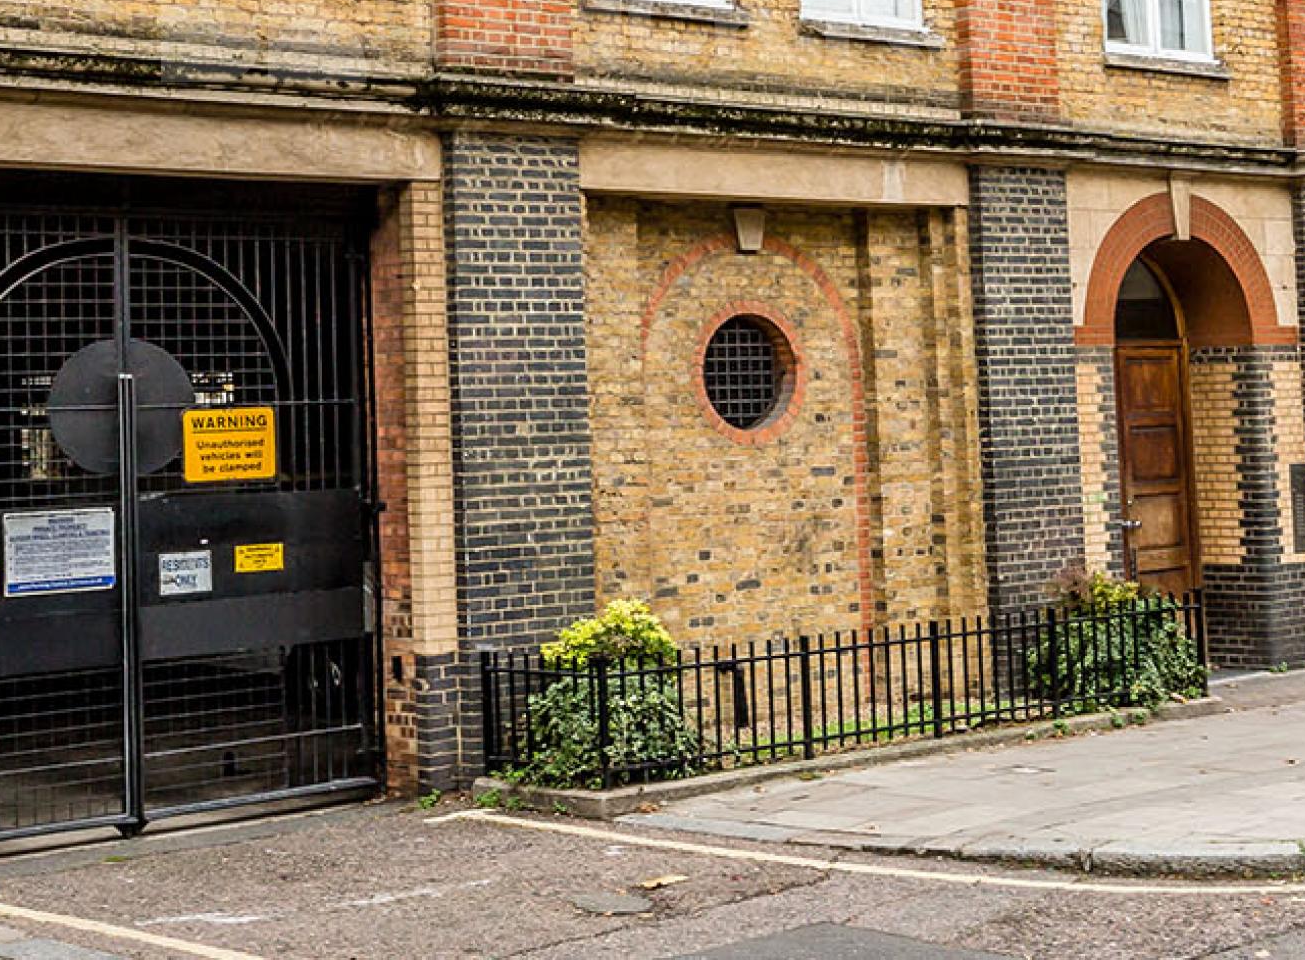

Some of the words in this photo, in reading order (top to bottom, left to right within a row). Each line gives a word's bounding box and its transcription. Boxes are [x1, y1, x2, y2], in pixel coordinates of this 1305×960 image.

[191, 415, 268, 428] WARNING
[196, 438, 265, 450] Unauthorised
[199, 452, 241, 461] vehicles
[245, 450, 263, 458] will
[203, 464, 215, 474] be
[219, 462, 262, 473] clamped
